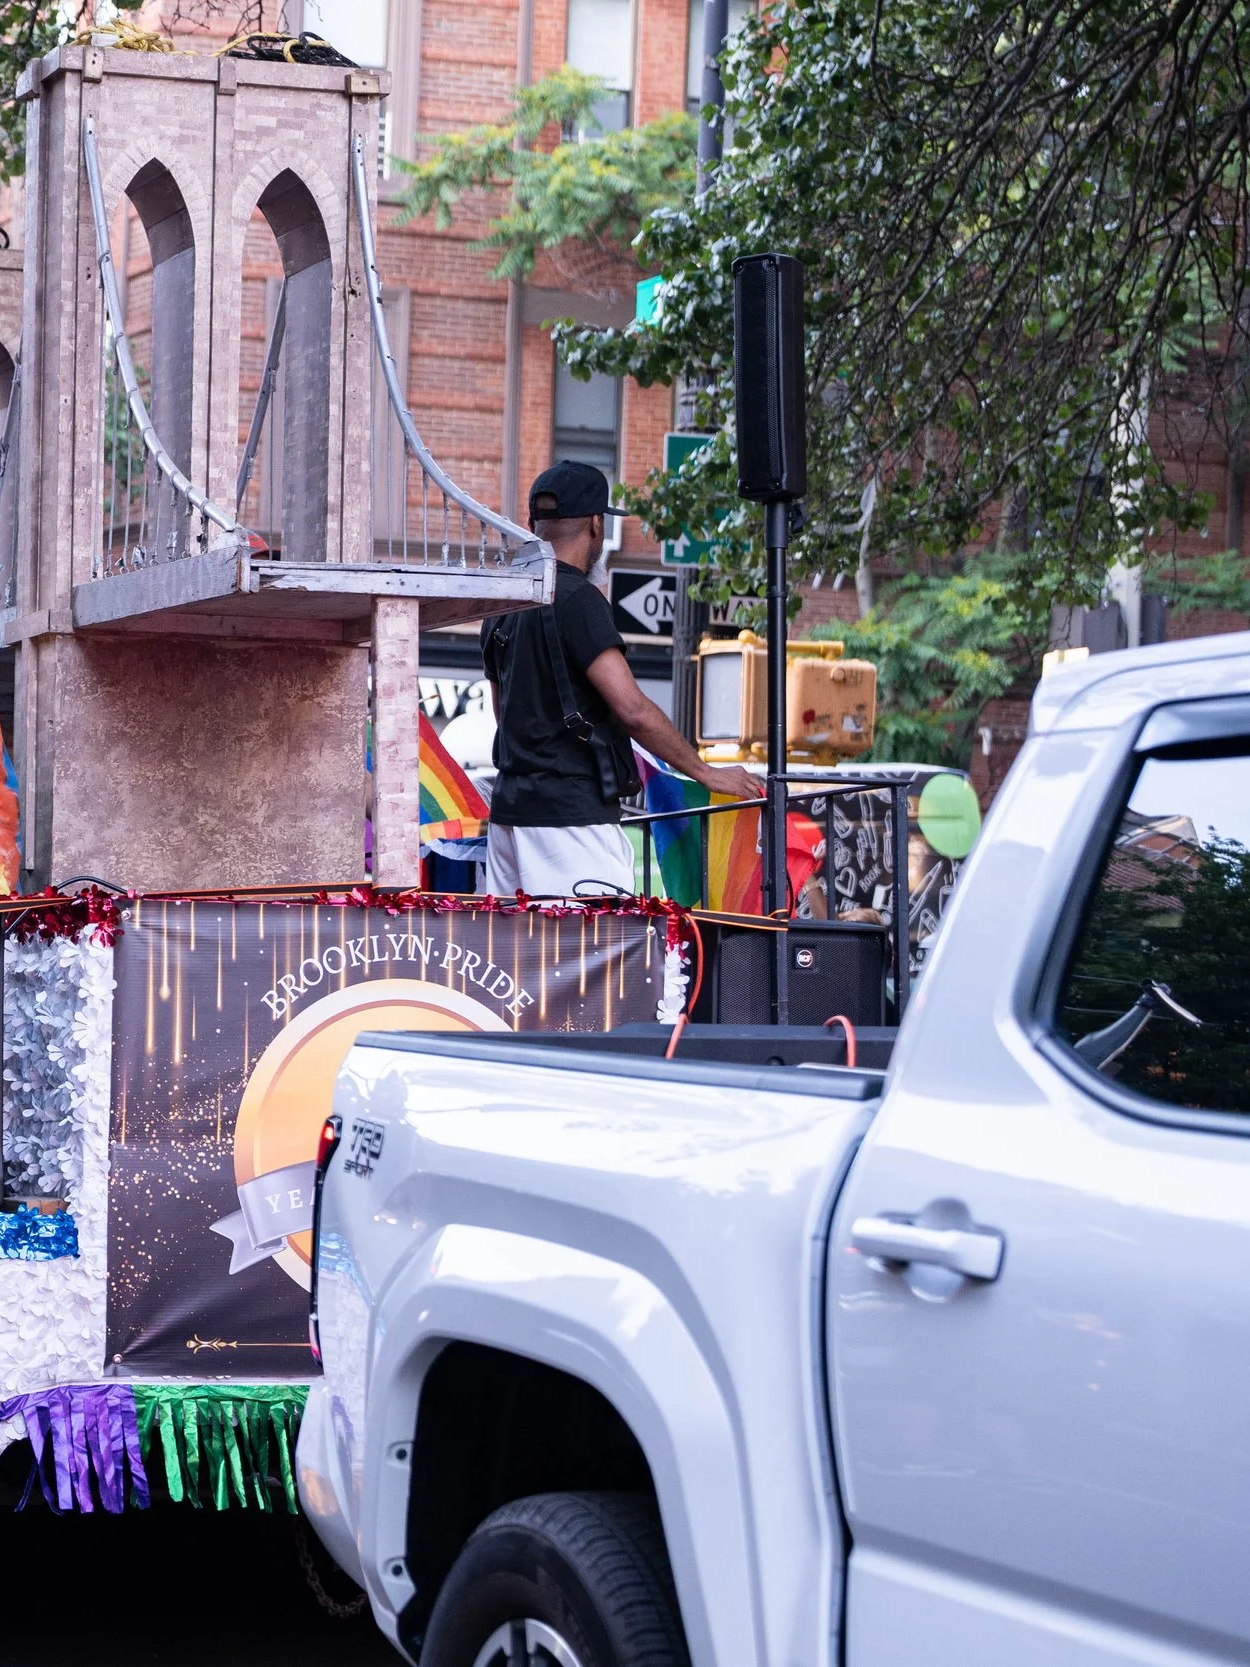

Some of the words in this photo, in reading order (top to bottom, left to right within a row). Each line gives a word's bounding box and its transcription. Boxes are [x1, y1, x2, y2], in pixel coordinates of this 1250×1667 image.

[643, 593, 676, 617] ON
[260, 933, 435, 1020] BROOKLYN
[439, 941, 535, 1018] PRIDE
[351, 1118, 385, 1167] TRD
[265, 1186, 316, 1215] YE
